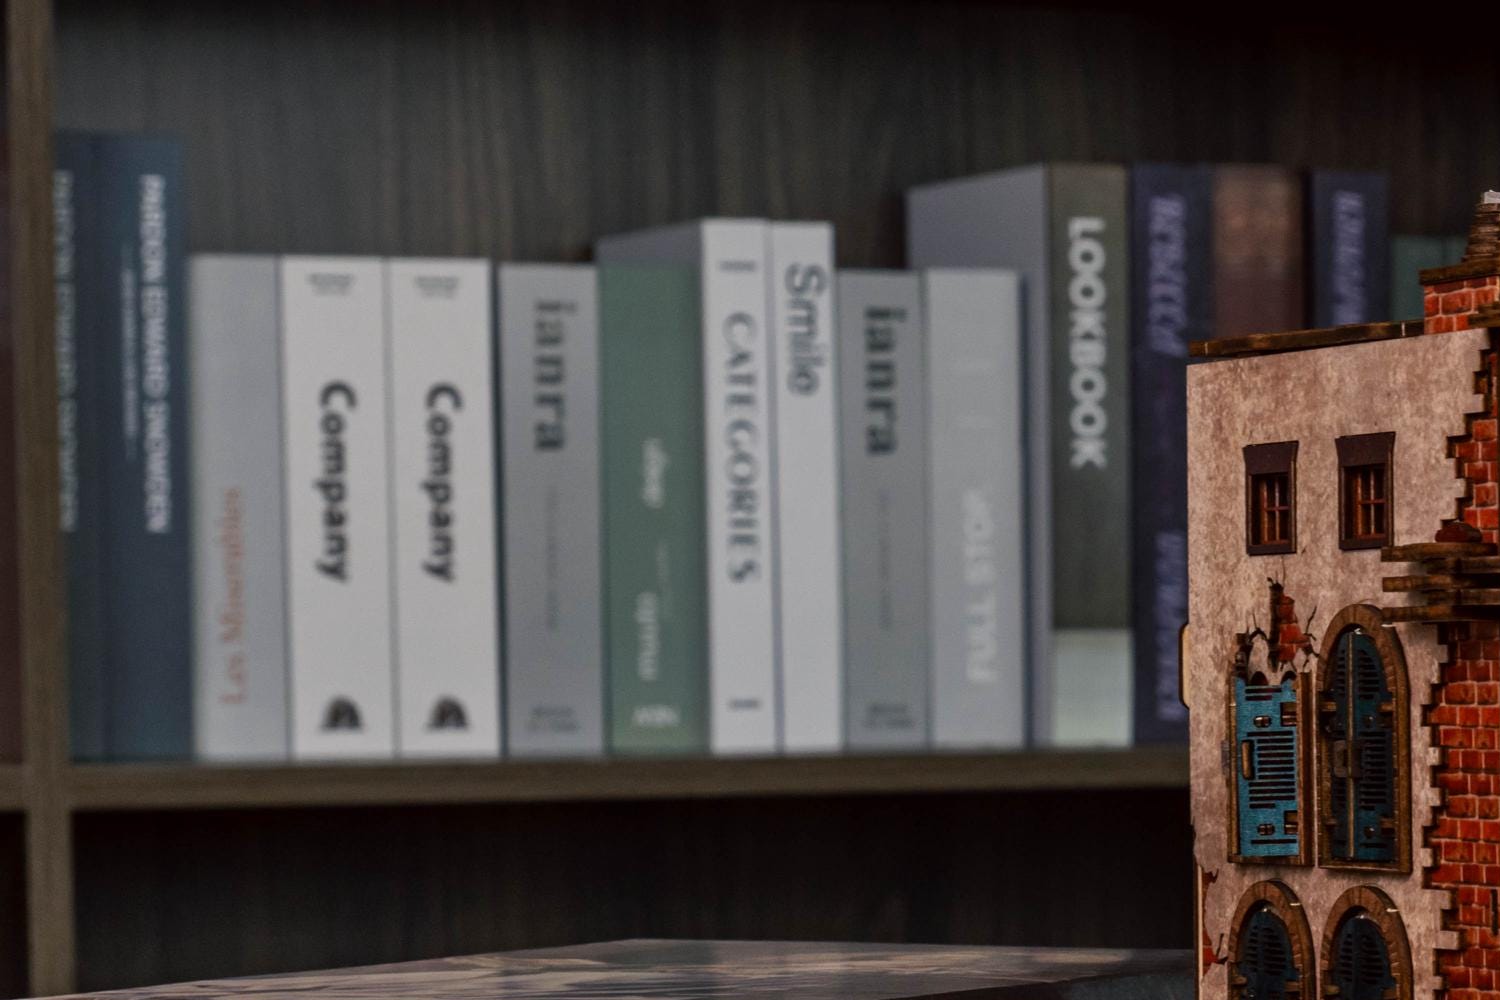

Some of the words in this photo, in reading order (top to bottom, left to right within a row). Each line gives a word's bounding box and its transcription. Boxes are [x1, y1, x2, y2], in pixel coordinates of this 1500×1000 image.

[785, 261, 828, 398] Smile
[1067, 216, 1109, 469] LOOKBOOK
[313, 380, 357, 583] Company
[420, 381, 463, 583] Company
[719, 311, 762, 585] CATEGORIES
